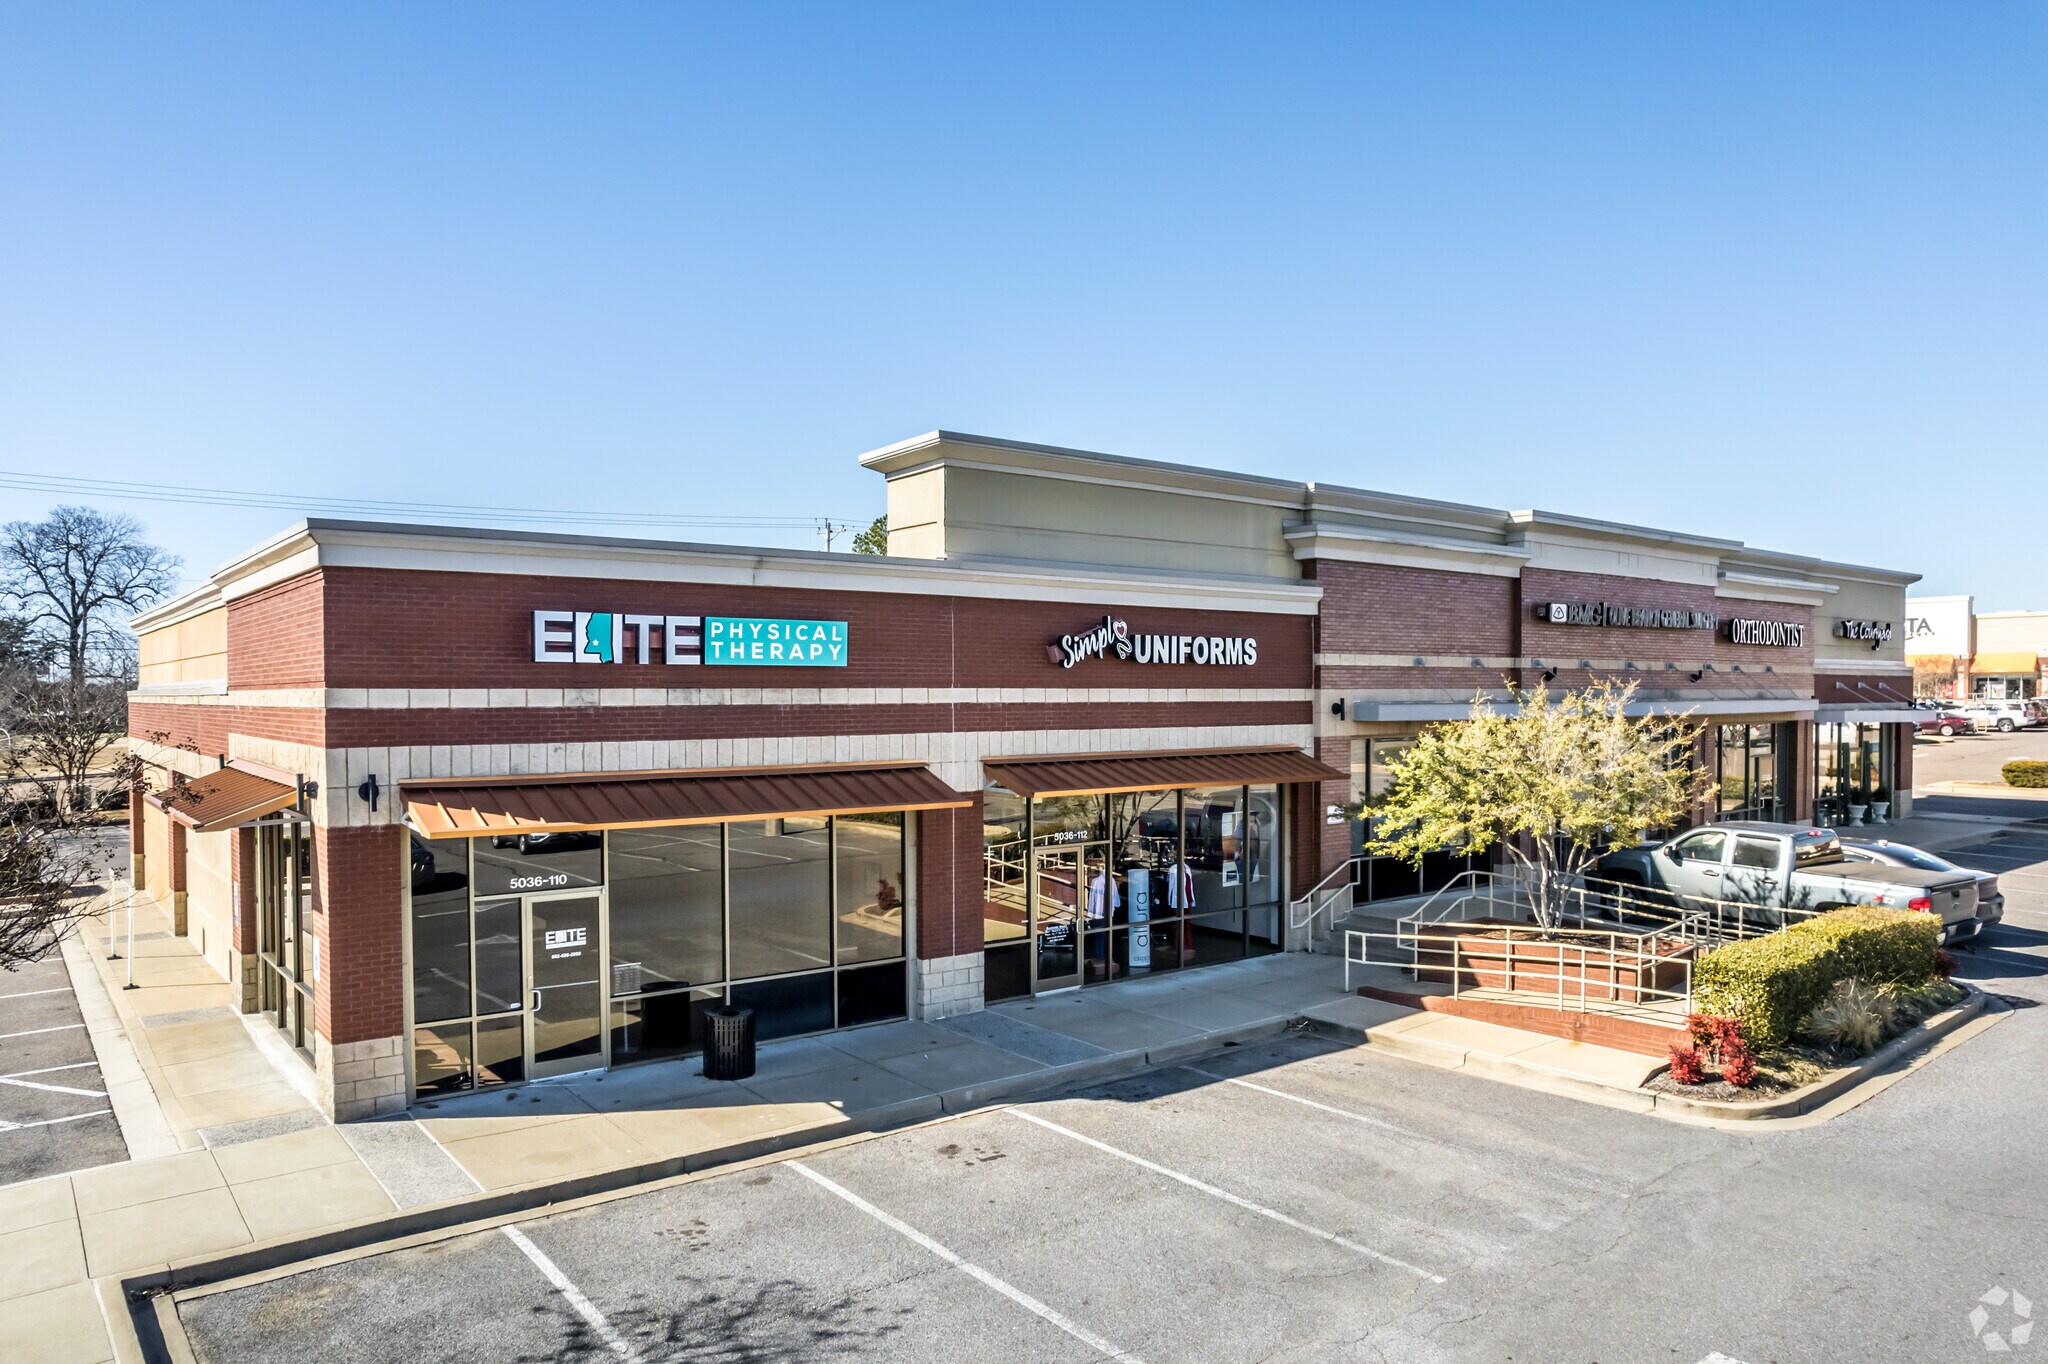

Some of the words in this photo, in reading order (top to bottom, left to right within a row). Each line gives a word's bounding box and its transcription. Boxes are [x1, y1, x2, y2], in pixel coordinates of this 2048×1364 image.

[533, 610, 701, 665] ELITE
[711, 621, 843, 642] PHYSICAL
[1732, 618, 1804, 648] ORTHODONTIST
[1845, 620, 1859, 640] The
[710, 641, 844, 662] THERAPY
[1134, 634, 1258, 666] UNIFORMS
[1054, 830, 1088, 841] 5036-112
[509, 874, 568, 889] 5036-110
